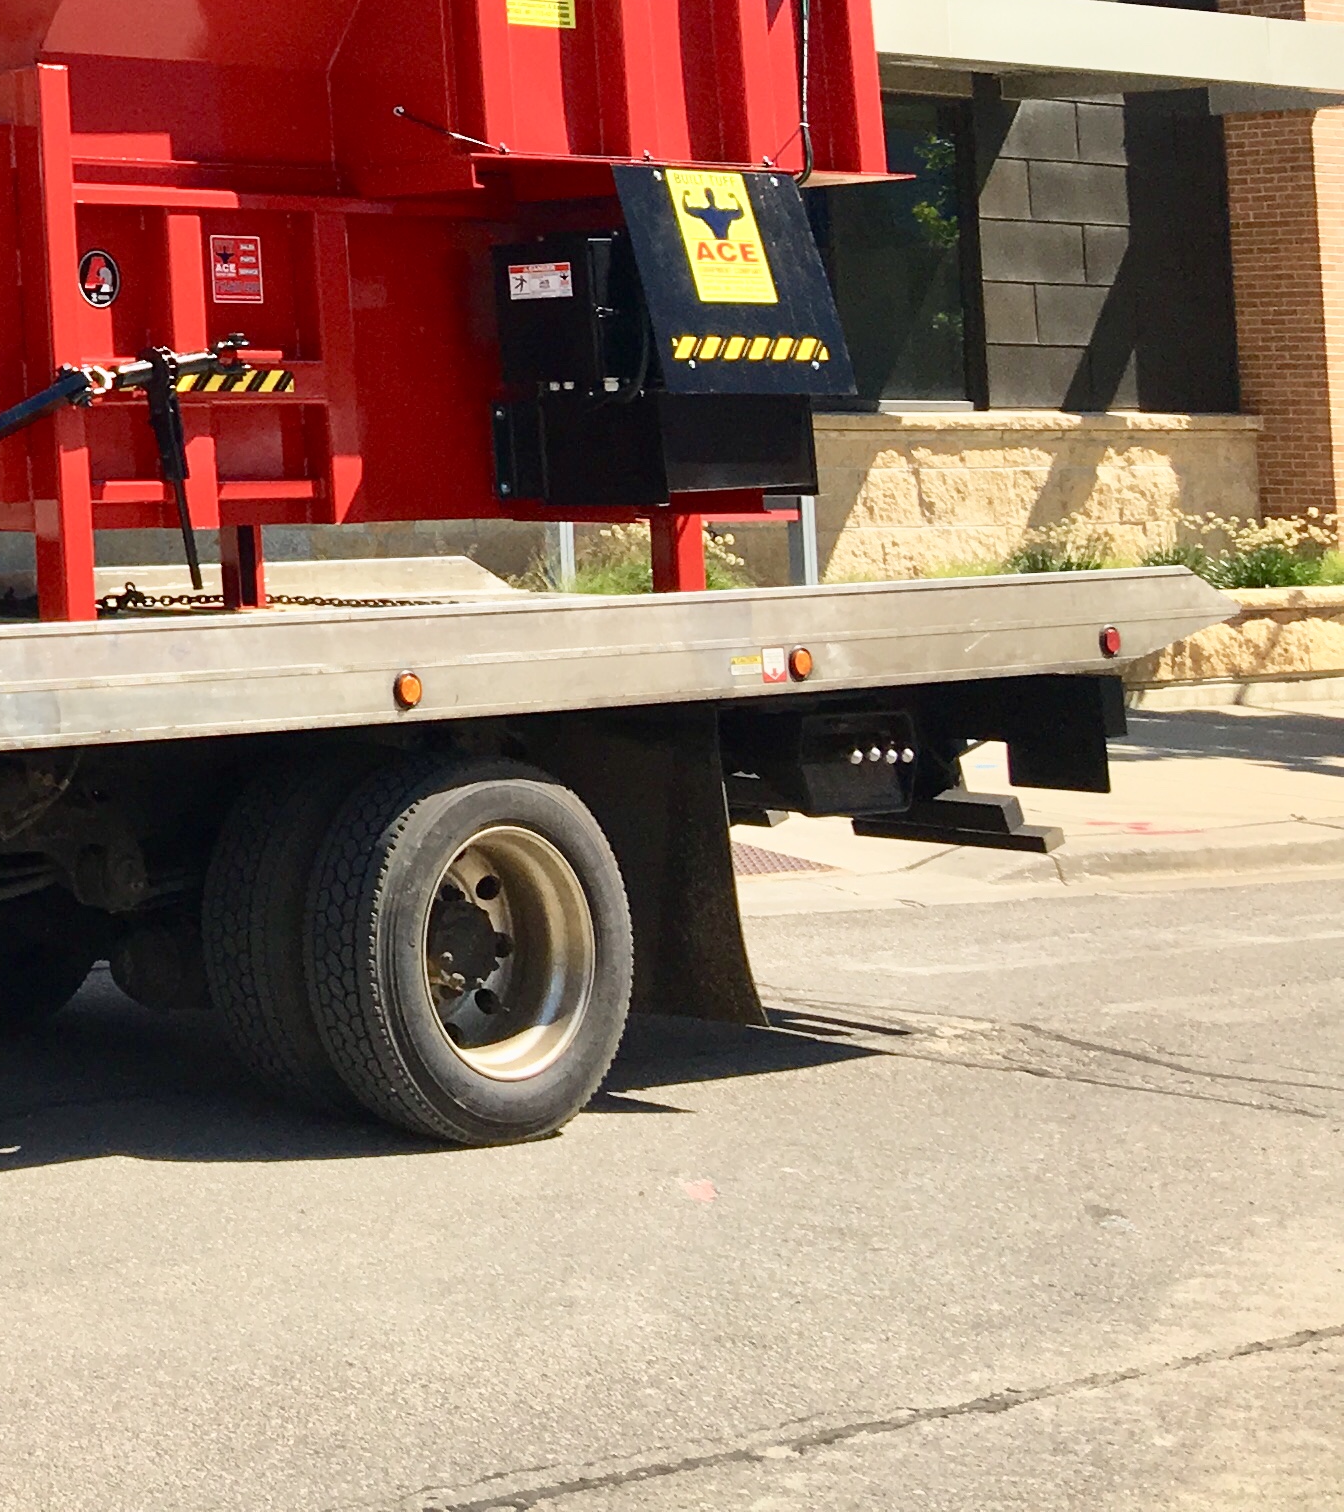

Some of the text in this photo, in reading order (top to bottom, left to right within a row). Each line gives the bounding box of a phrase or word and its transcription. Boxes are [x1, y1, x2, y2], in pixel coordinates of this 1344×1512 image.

[674, 173, 738, 187] BUILT TUFF
[697, 241, 760, 262] ACE
[215, 263, 236, 273] ACE
